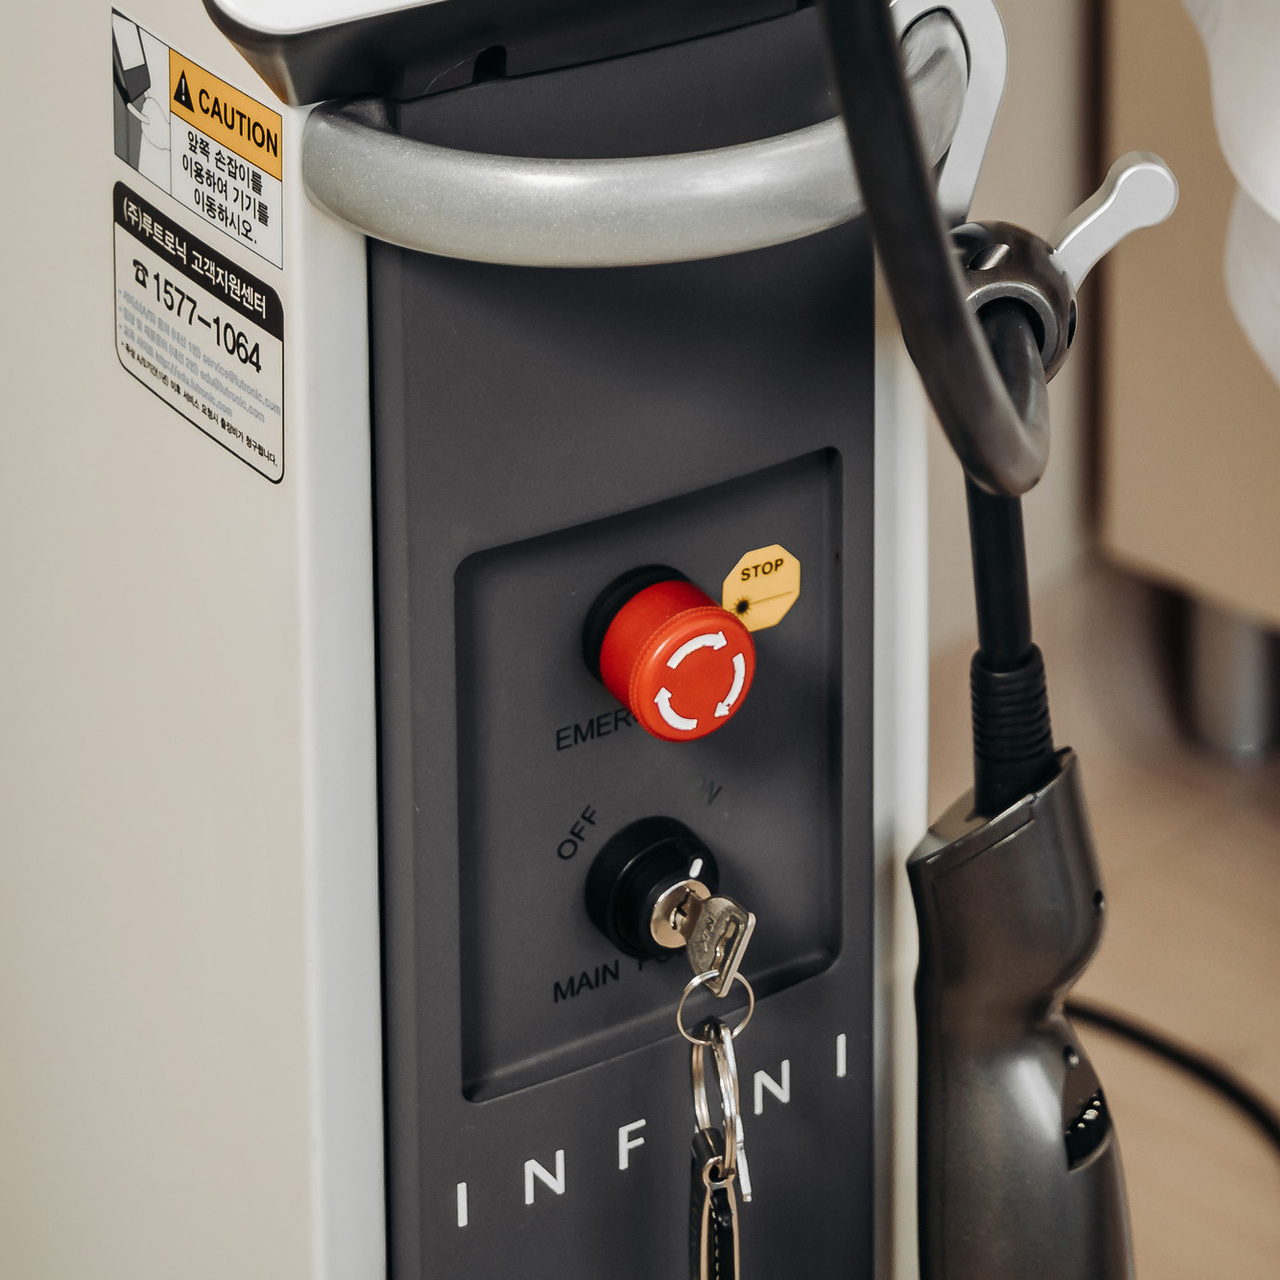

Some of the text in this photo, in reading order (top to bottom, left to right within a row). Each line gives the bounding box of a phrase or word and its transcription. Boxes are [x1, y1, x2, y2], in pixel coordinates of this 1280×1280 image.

[199, 88, 278, 158] CAUTION
[182, 153, 269, 227] 이용하여 기기를
[187, 130, 263, 196] 앞쪽 손잡이를
[193, 188, 258, 244] 이동하시오.
[122, 196, 267, 320] (주)루트로닉 고객지원센터
[153, 271, 263, 374] 1577-1064
[741, 558, 784, 582] STOP
[556, 706, 639, 752] EMER
[556, 803, 597, 861] OFF
[553, 958, 621, 1004] MAIN
[456, 1033, 848, 1228] INFNI
